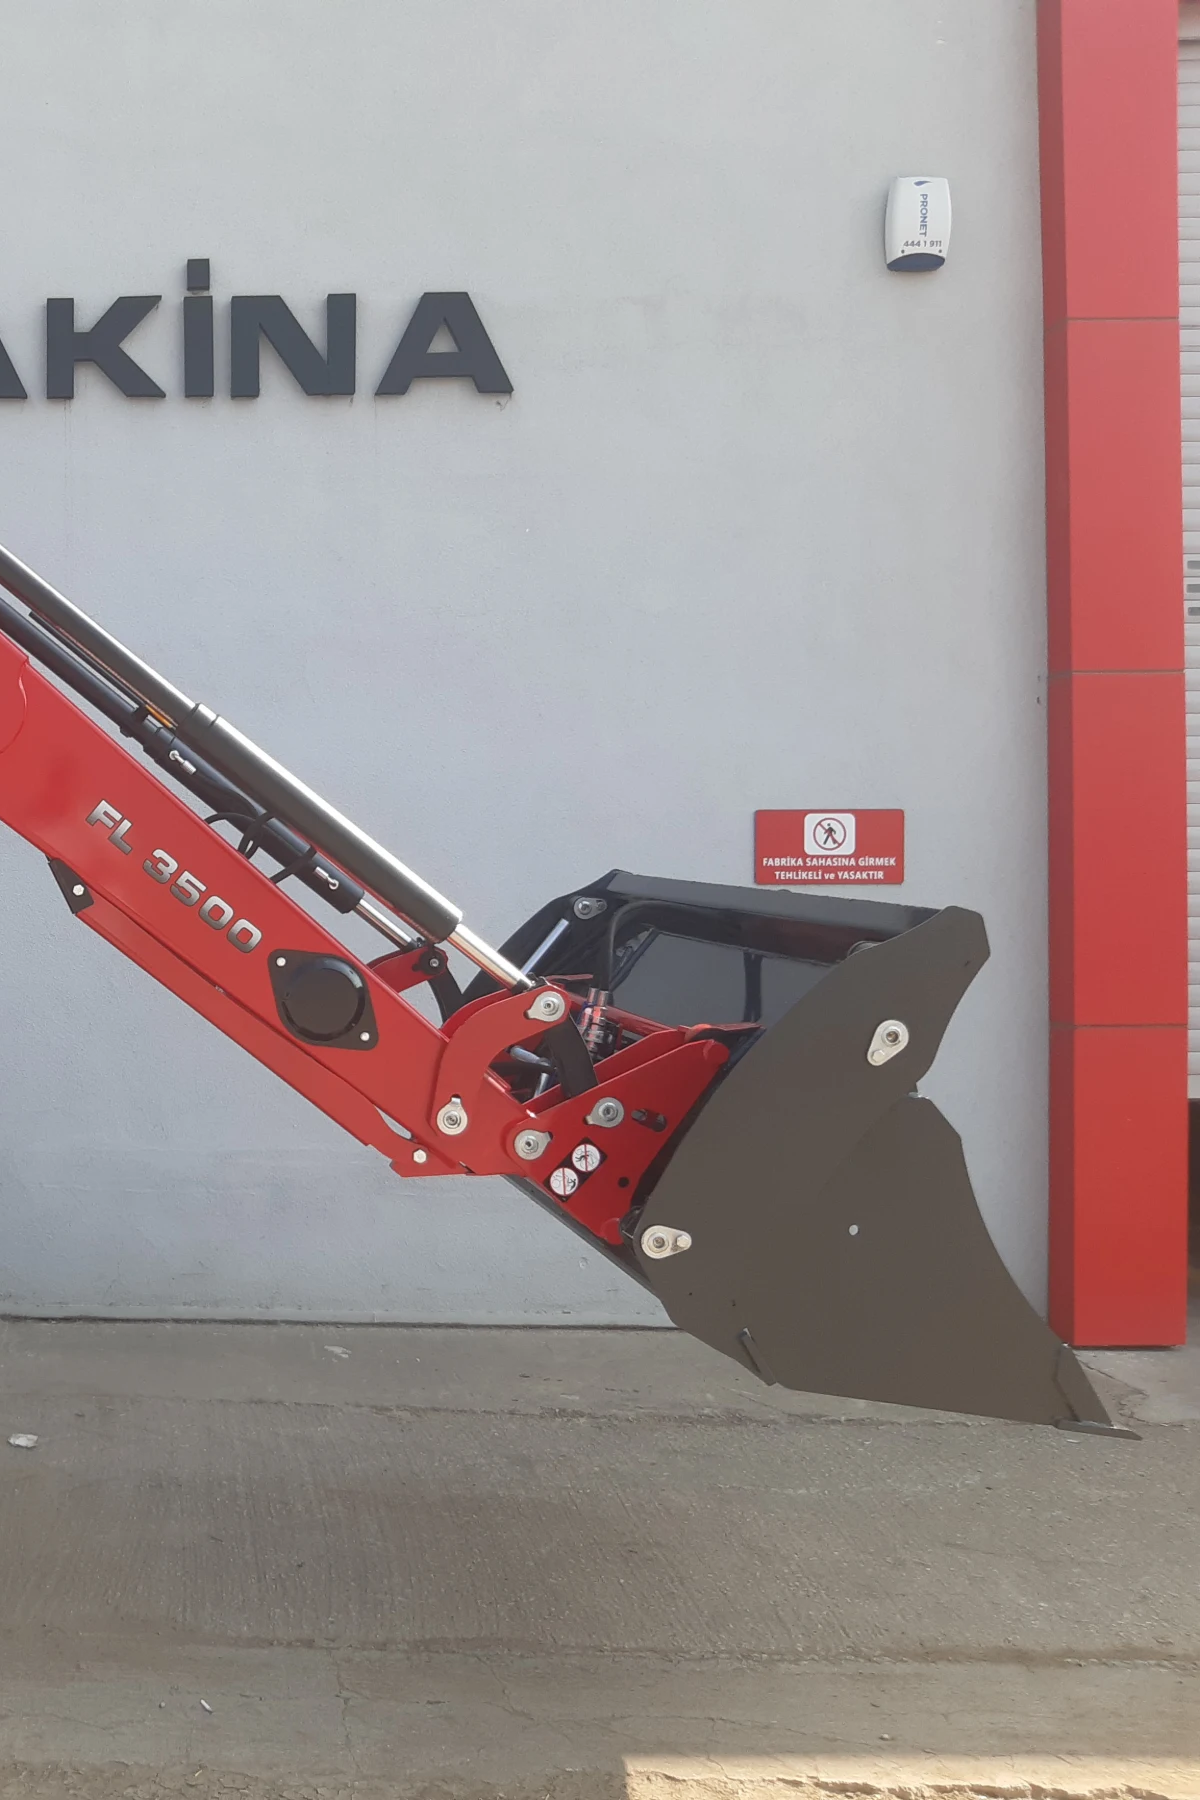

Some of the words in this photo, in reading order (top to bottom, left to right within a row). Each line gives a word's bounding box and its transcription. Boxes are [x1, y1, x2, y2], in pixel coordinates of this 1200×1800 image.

[919, 193, 929, 237] PRONET
[903, 240, 921, 248] 444
[929, 240, 942, 248] 911
[762, 856, 803, 867] FABRİKA
[805, 857, 856, 867] SAHASINA
[858, 855, 896, 867] GİRMEK
[85, 799, 133, 855] FL
[142, 848, 263, 953] 3500
[774, 869, 822, 880] TEHLİKELİ
[824, 872, 835, 880] ve
[837, 871, 884, 880] YASAKTIR
